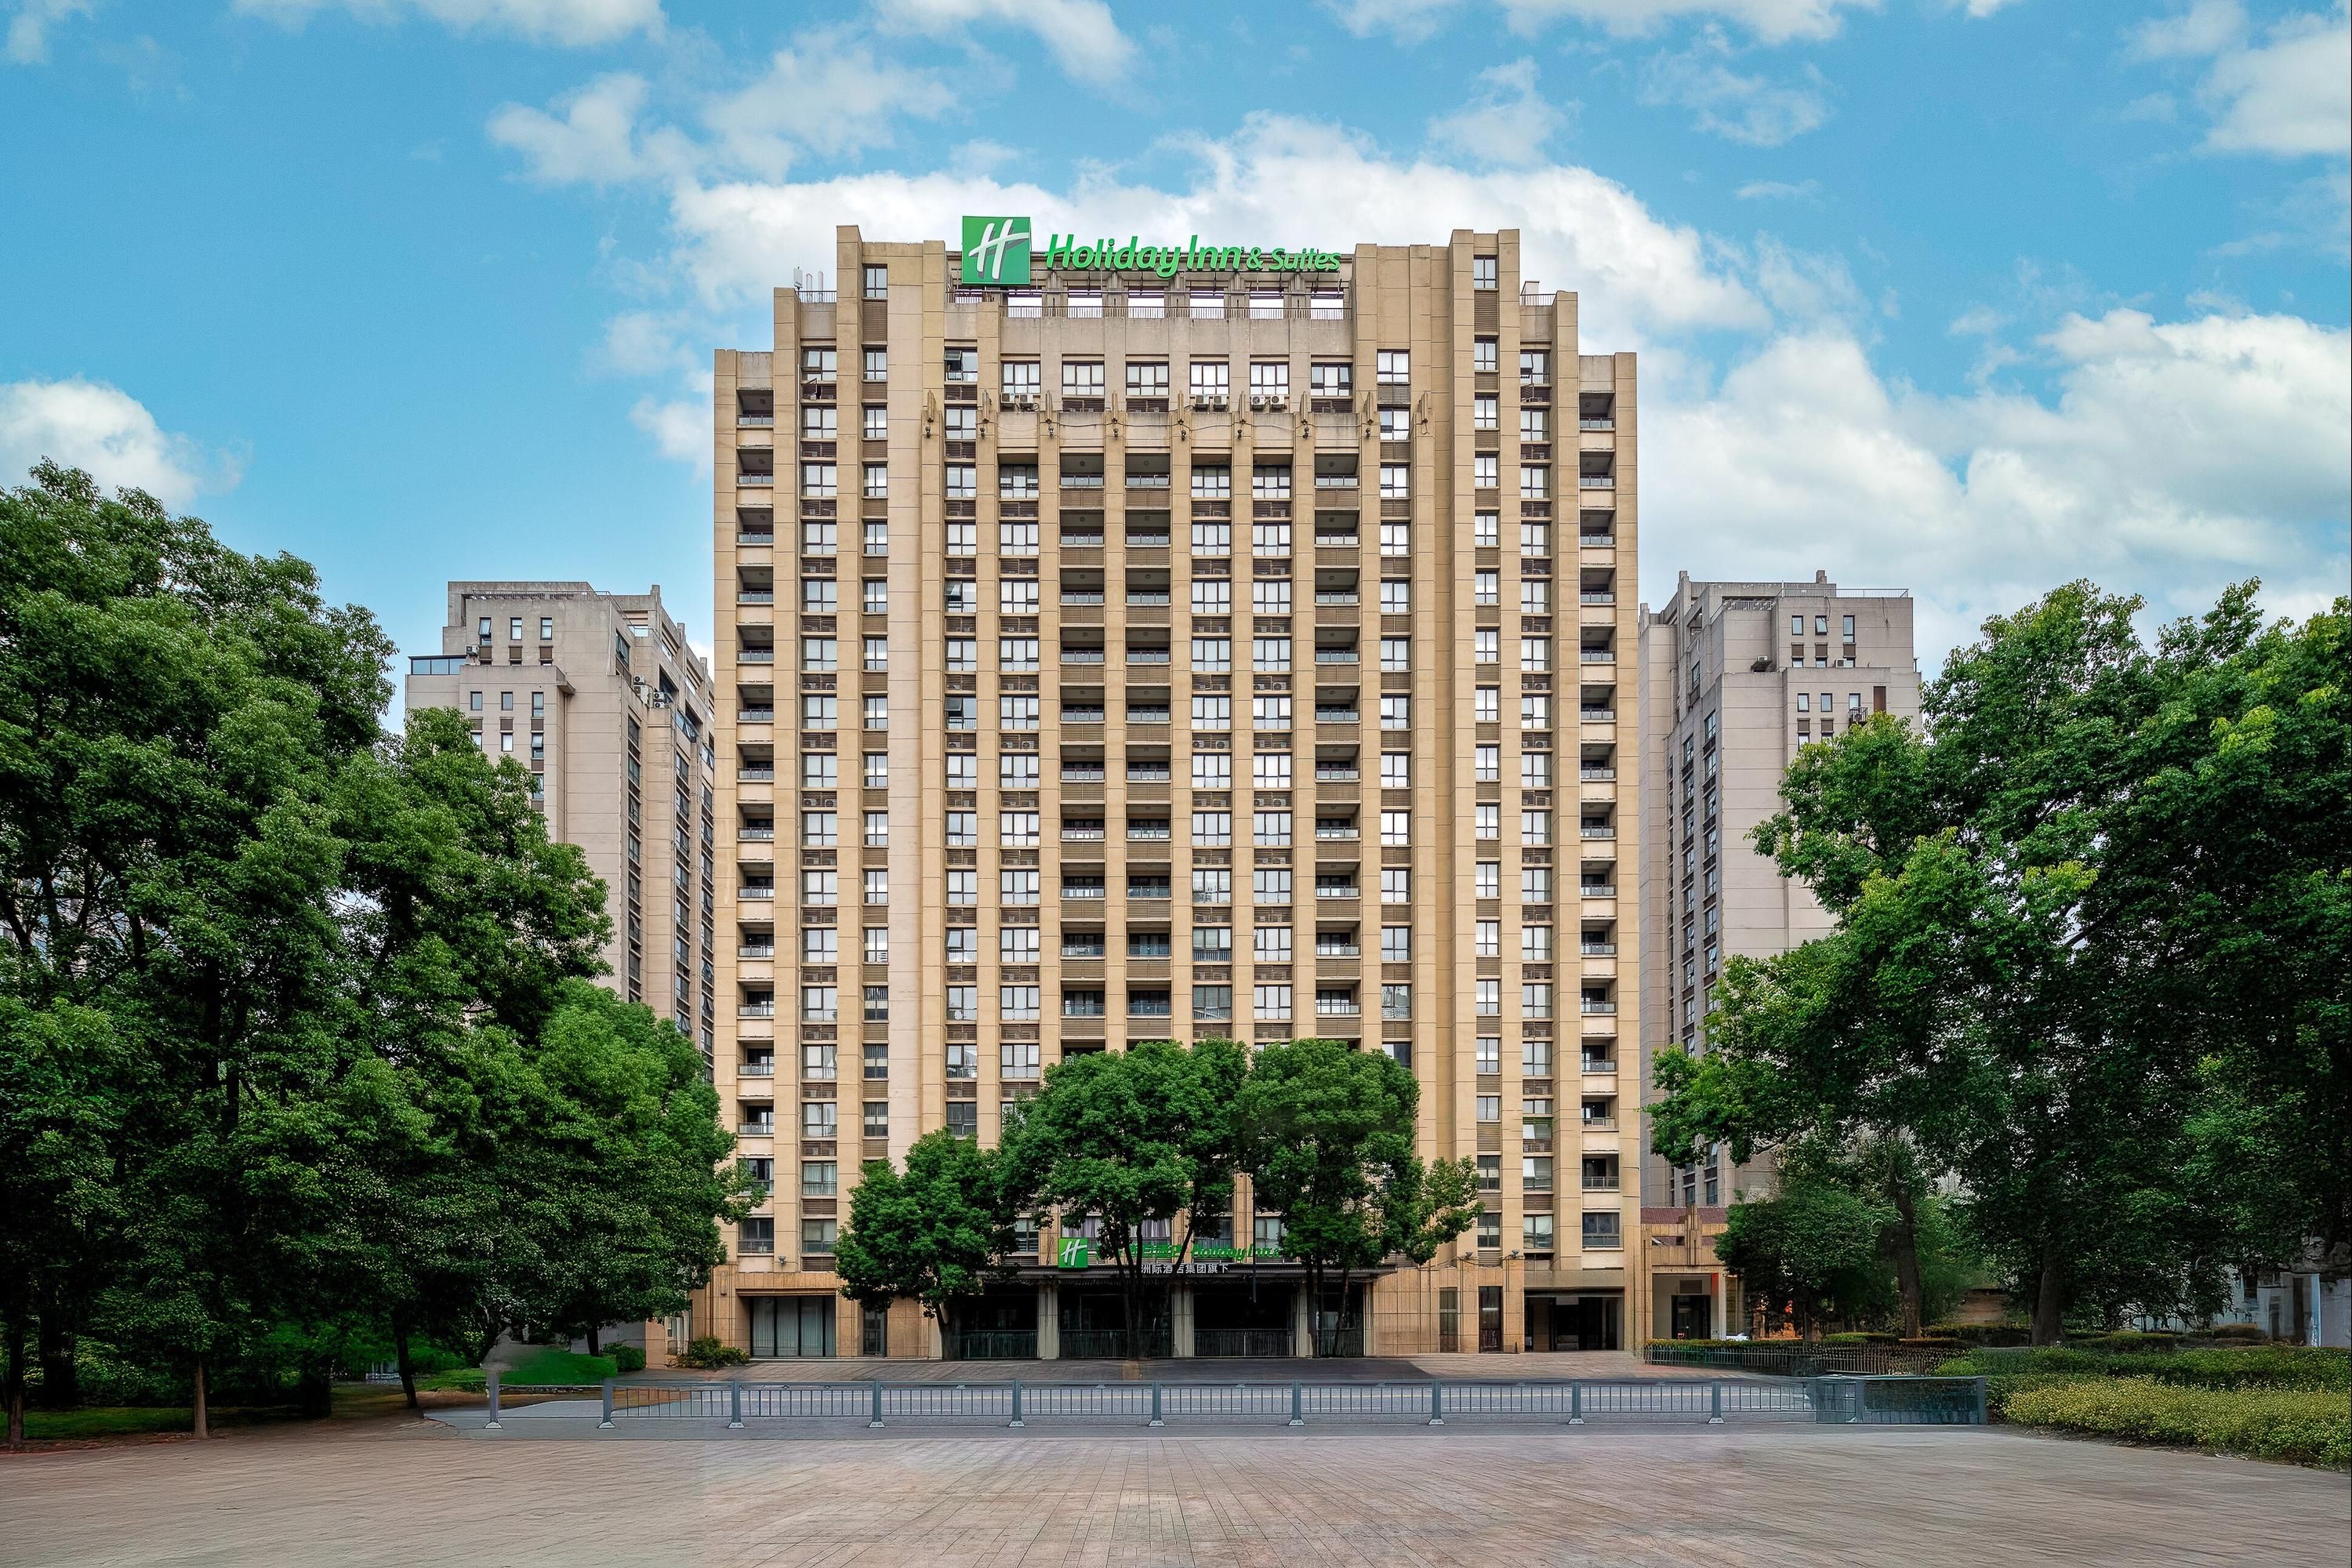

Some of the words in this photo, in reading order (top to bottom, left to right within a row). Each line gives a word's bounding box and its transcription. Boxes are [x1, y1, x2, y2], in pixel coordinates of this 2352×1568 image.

[1044, 234, 1181, 279] Holiday
[1186, 234, 1241, 270] Inn
[1247, 246, 1264, 270] &
[1269, 249, 1341, 272] Suites
[1141, 1263, 1229, 1274] 洲际酒店集团旗下
